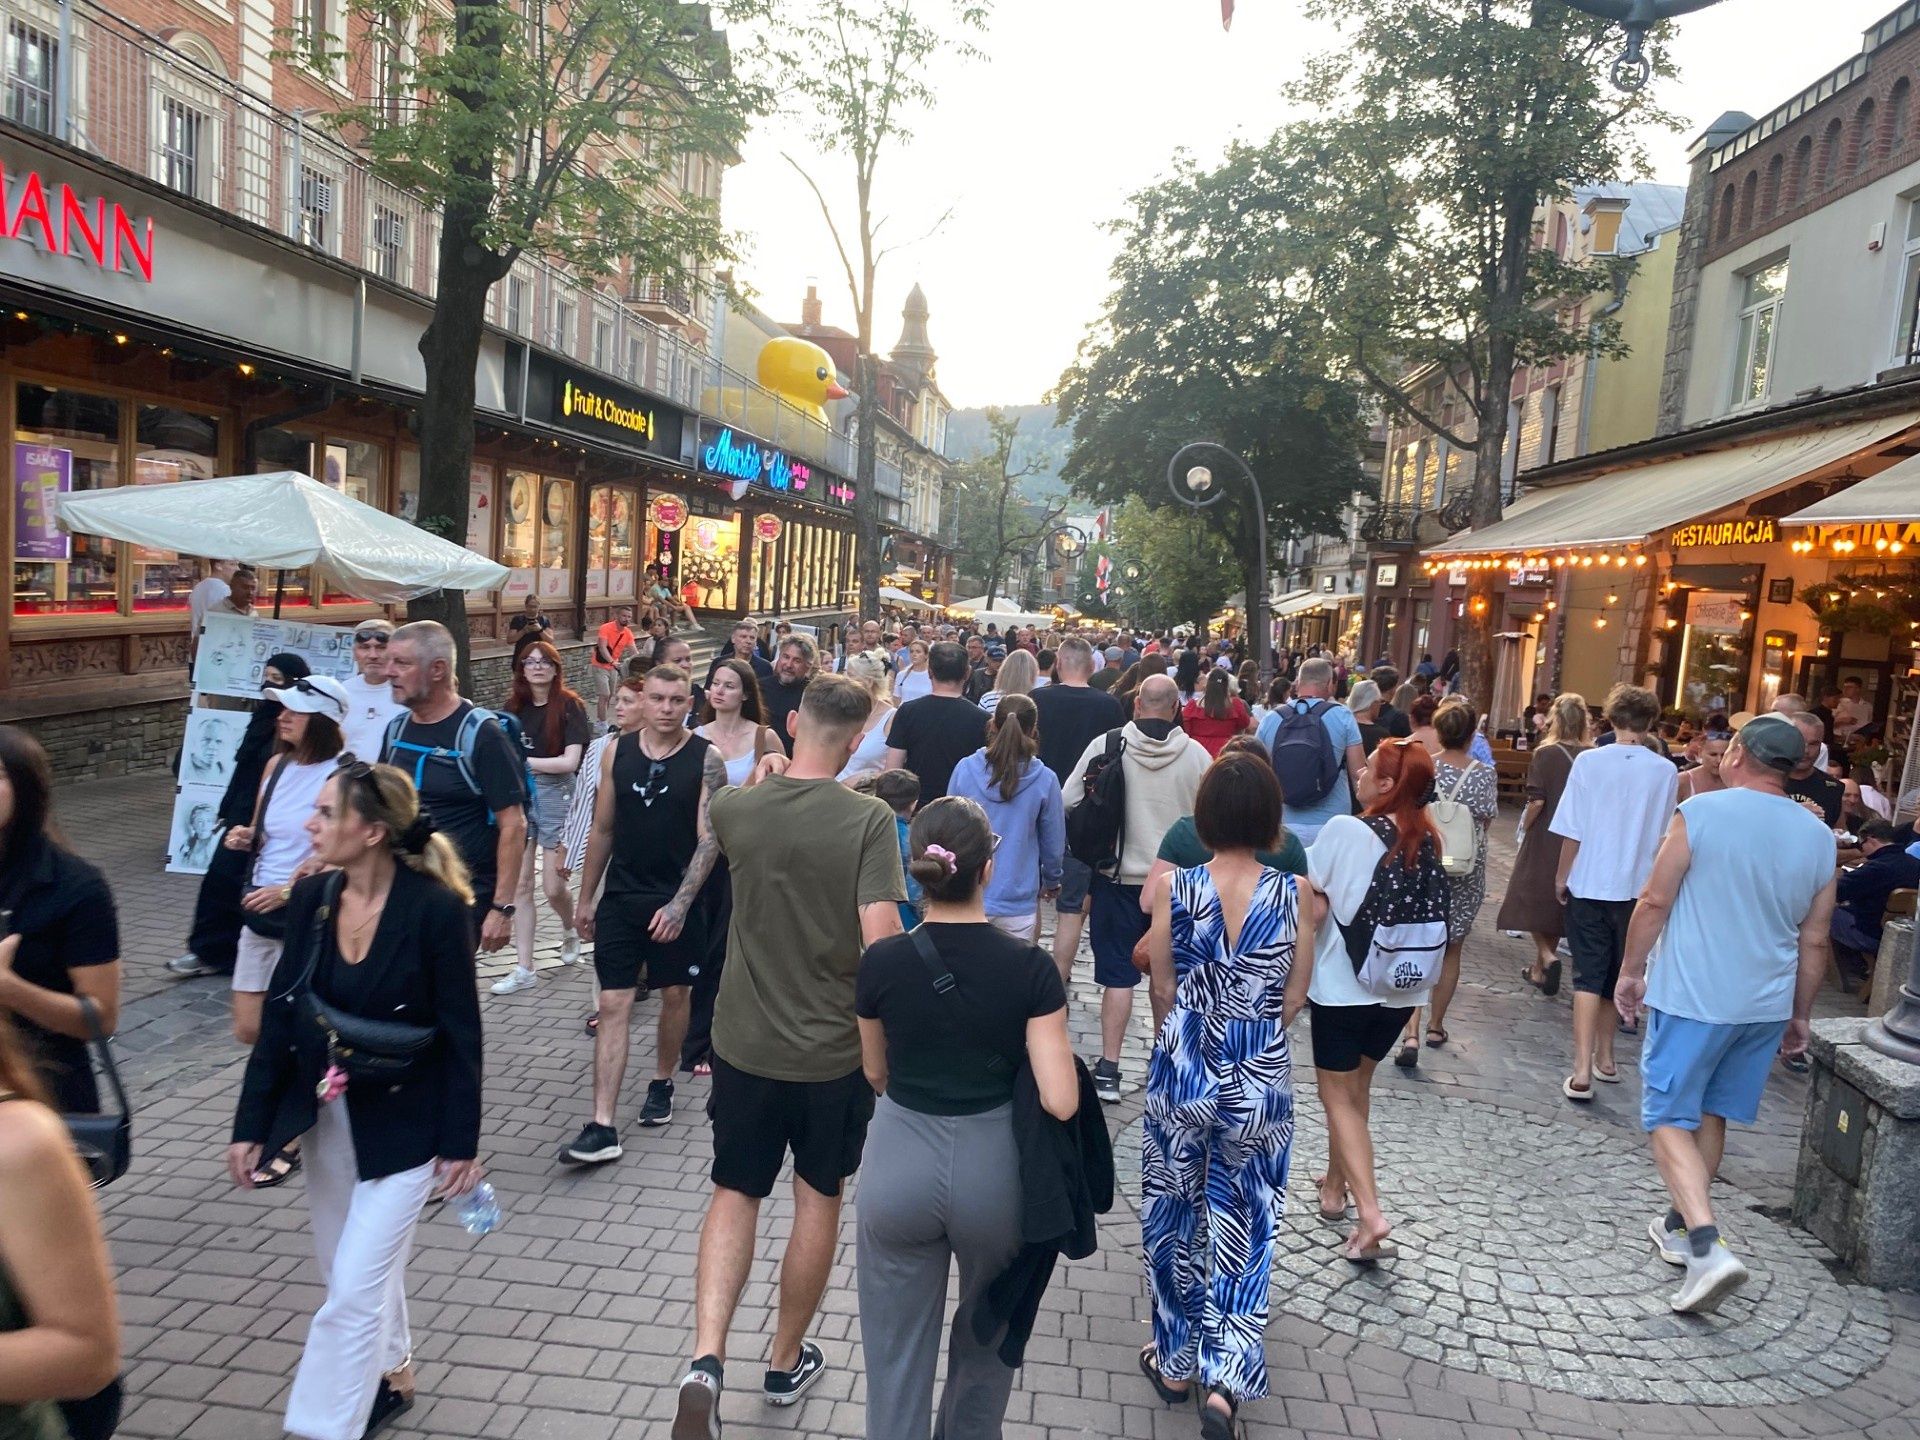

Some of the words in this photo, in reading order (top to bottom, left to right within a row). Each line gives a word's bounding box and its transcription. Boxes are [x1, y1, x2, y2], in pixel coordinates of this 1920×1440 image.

[0, 160, 154, 284] ANN
[573, 387, 595, 416] Fruit
[595, 397, 603, 419] &
[603, 399, 647, 433] Chocolate
[705, 427, 762, 482] Morskie
[1672, 519, 1774, 548] RESTAURACJA
